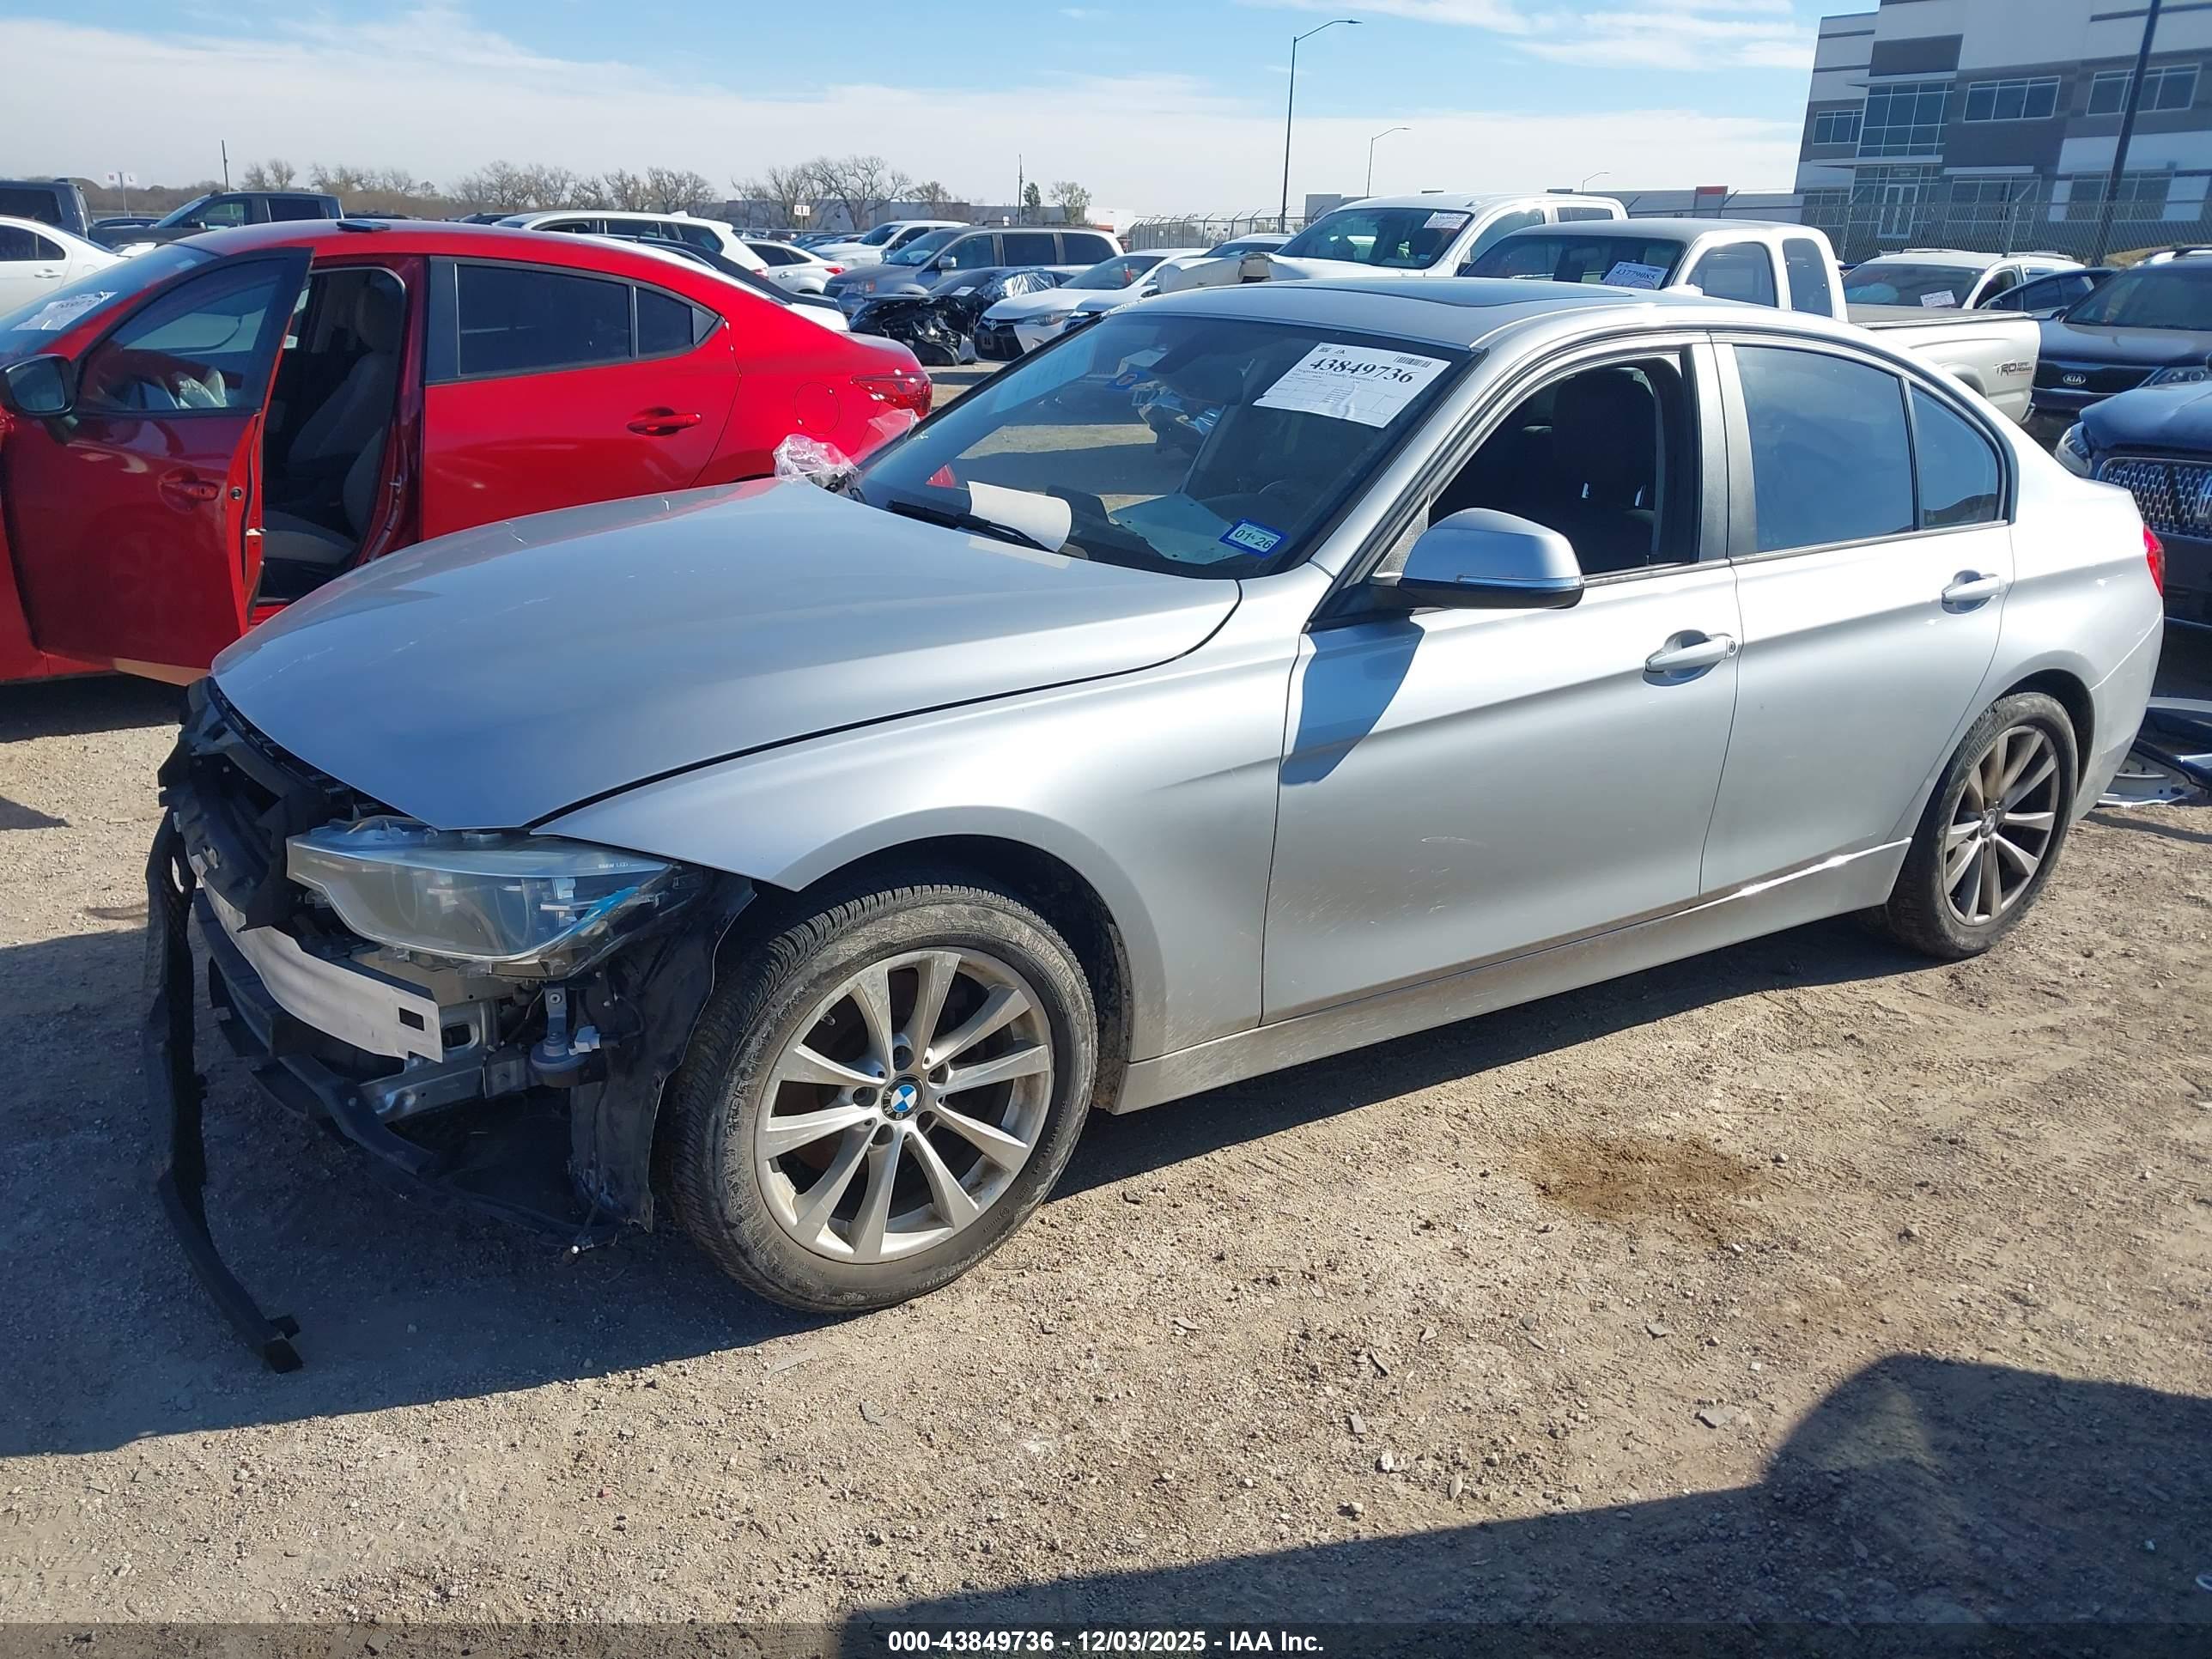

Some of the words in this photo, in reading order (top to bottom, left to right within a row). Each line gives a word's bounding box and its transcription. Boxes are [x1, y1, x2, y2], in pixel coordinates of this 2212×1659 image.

[1310, 357, 1420, 384] 43849736
[1235, 529, 1253, 542] 01
[1254, 537, 1274, 549] 26
[884, 1091, 903, 1119] BMW
